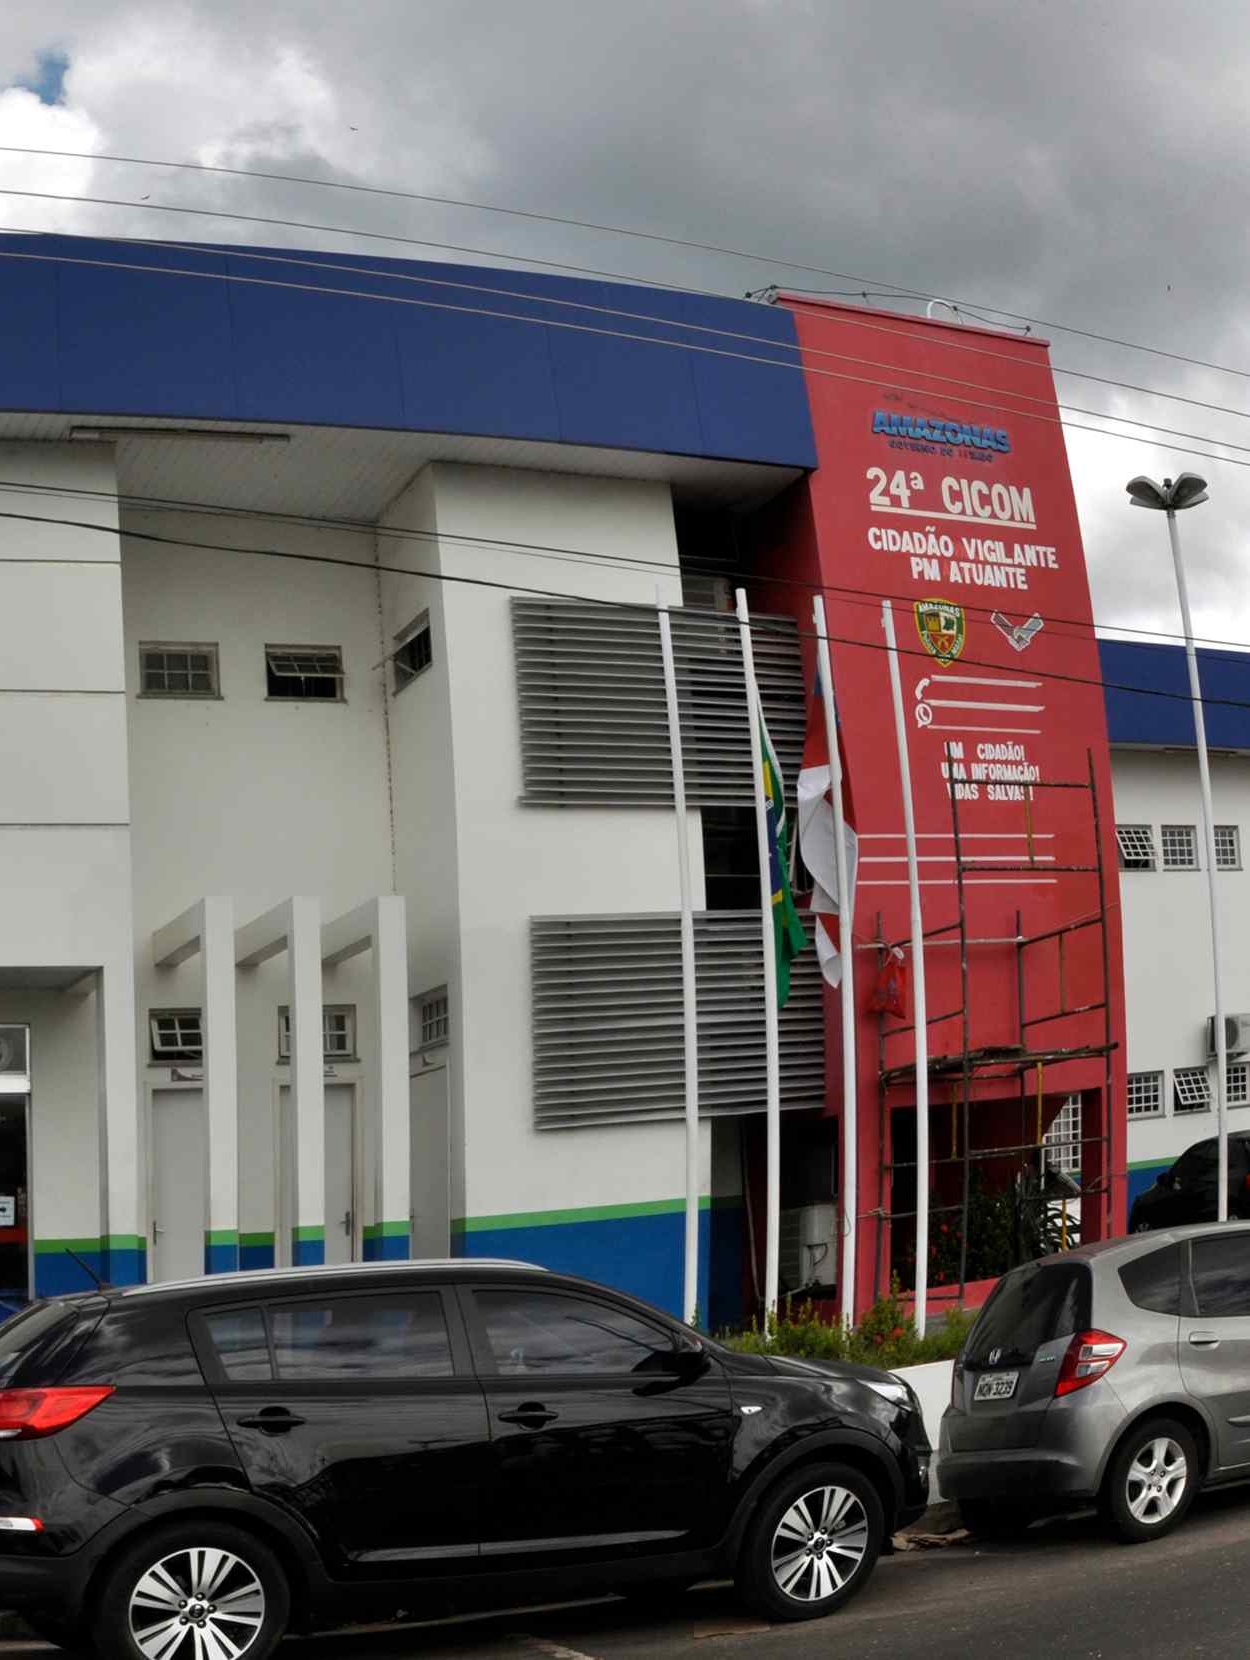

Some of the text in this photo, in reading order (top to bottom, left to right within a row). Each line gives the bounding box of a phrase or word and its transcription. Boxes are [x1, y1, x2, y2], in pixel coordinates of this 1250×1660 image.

[872, 409, 1011, 453] AMAZONAS
[866, 467, 1036, 522] 24ª CICOM
[868, 526, 1059, 569] CIDADÃO VIGILANTE
[910, 556, 1028, 590] PM ATUANTE
[977, 741, 1025, 761] CIDADÃO!
[971, 762, 1040, 782] INFORMAÇÃO!
